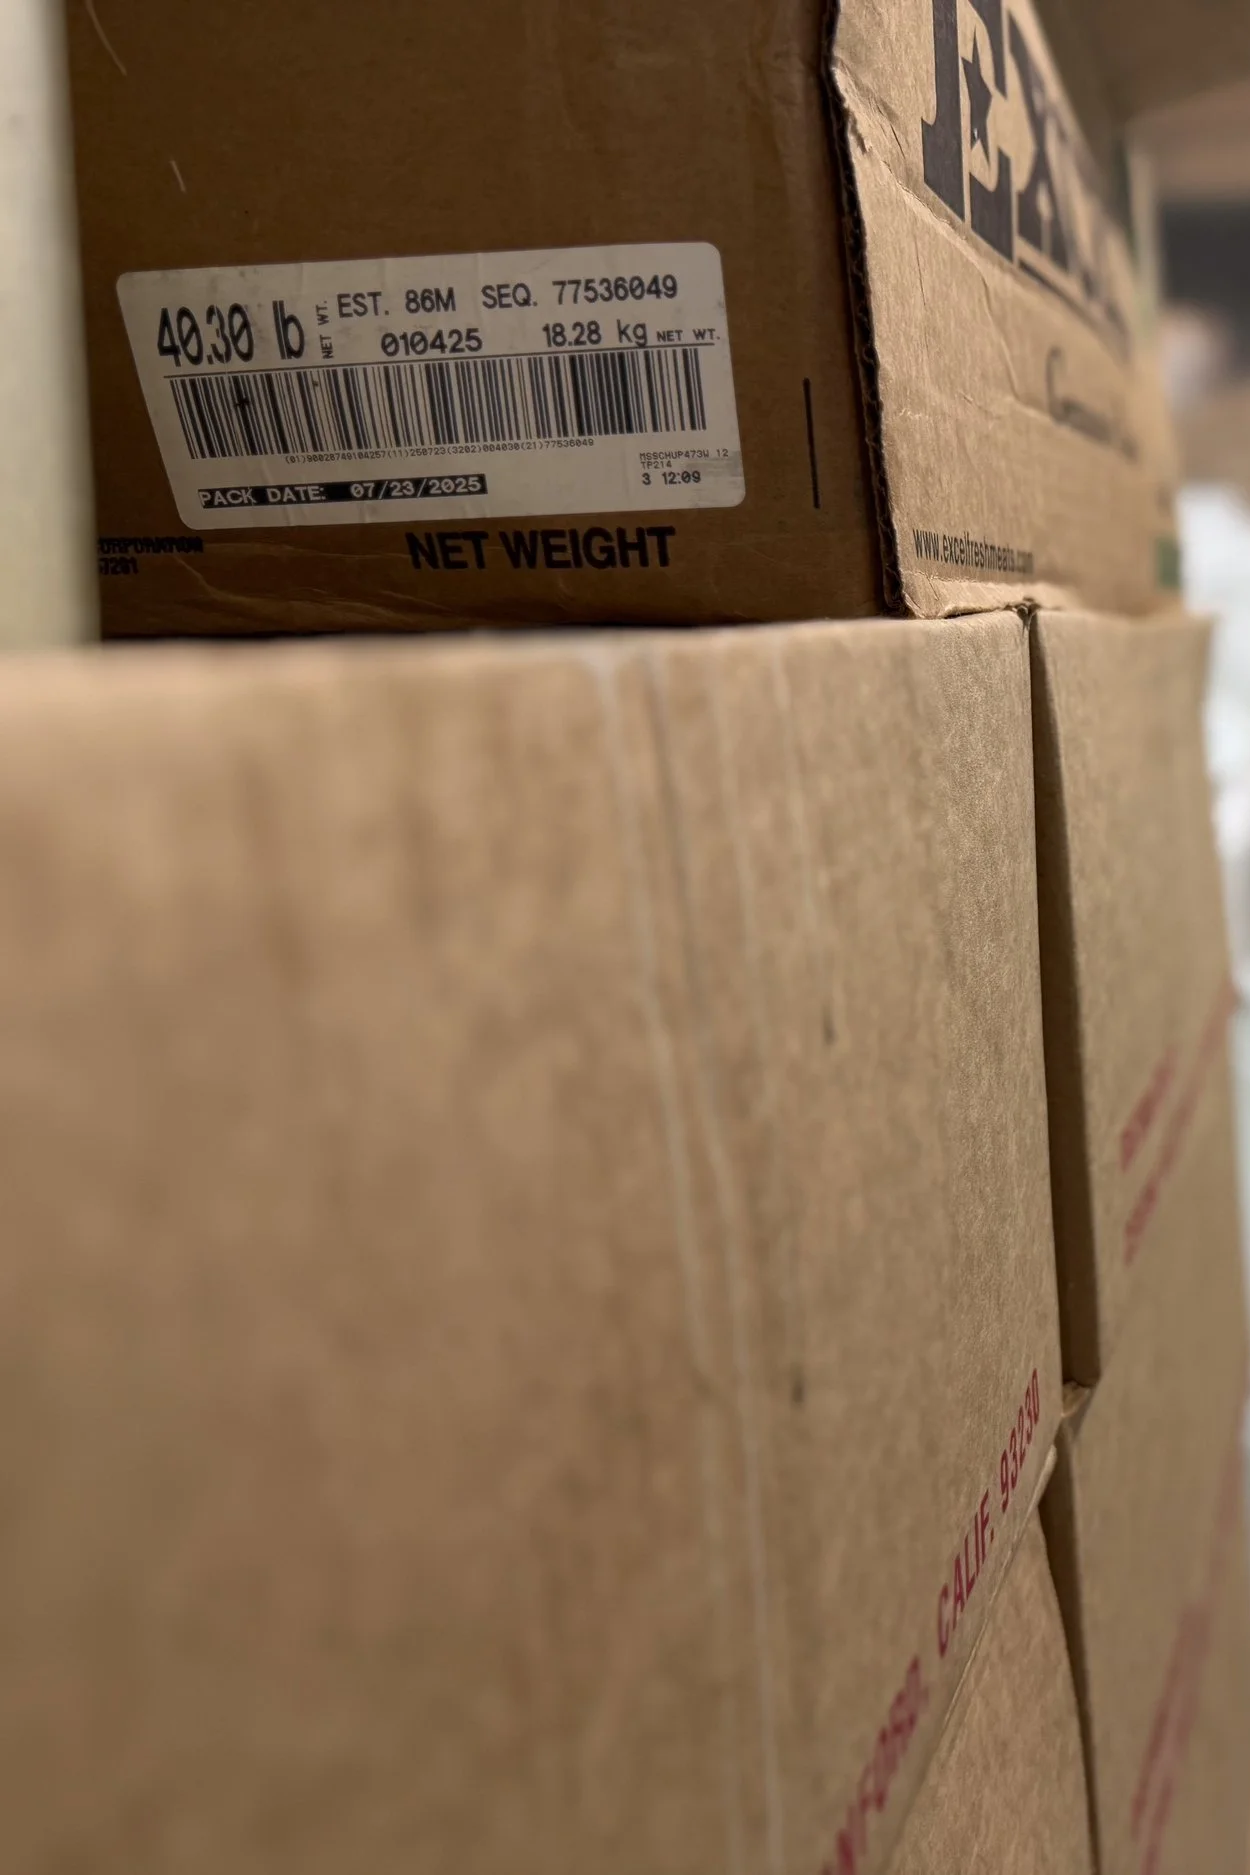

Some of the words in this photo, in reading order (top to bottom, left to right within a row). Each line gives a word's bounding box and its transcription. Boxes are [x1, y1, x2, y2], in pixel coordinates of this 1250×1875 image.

[337, 291, 389, 318] EST.
[405, 287, 457, 314] 86M
[481, 283, 538, 309] SEQ.
[552, 274, 678, 305] 77536049
[315, 300, 329, 326] WT.
[157, 303, 254, 367] 40.30
[272, 300, 305, 360] lb
[319, 334, 334, 360] NET
[381, 328, 483, 357] 010425
[543, 320, 602, 348] 18.28
[616, 319, 648, 347] kg
[656, 329, 684, 342] NET
[692, 328, 721, 341] WT.
[641, 460, 672, 470] TP214
[716, 448, 729, 458] 12
[199, 488, 253, 507] PACK
[267, 485, 327, 502] DATE:
[351, 476, 482, 500] 07/23/2025
[641, 472, 652, 486] 3
[661, 470, 702, 485] 12:09
[404, 530, 489, 570] NET
[498, 526, 676, 570] WEIGHT
[937, 1488, 995, 1660] CALIF.
[1000, 1367, 1041, 1514] 93230
